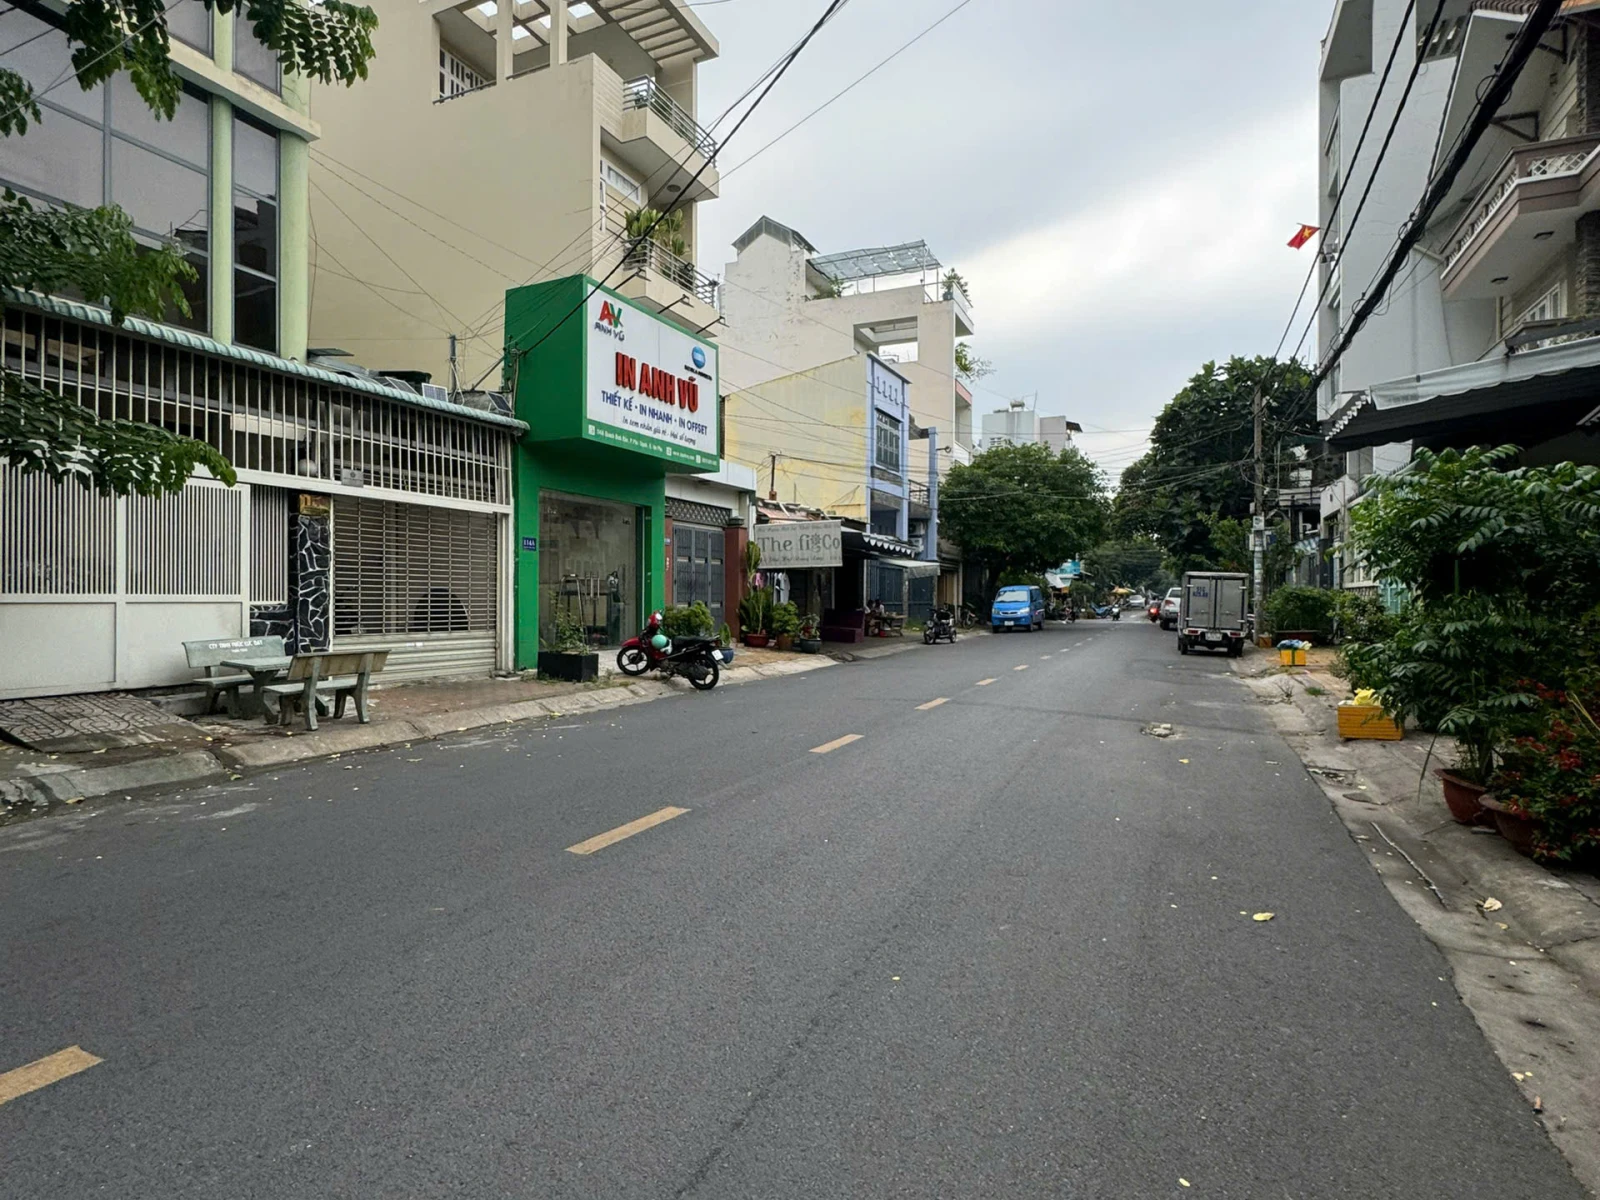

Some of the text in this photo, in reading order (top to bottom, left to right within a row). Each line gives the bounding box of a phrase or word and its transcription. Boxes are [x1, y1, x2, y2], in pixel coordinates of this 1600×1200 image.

[616, 352, 636, 390] IN
[639, 363, 675, 405] ANH
[601, 390, 708, 436] THIẾT KẾ IN NHANH IN OFFSET
[757, 537, 793, 552] The
